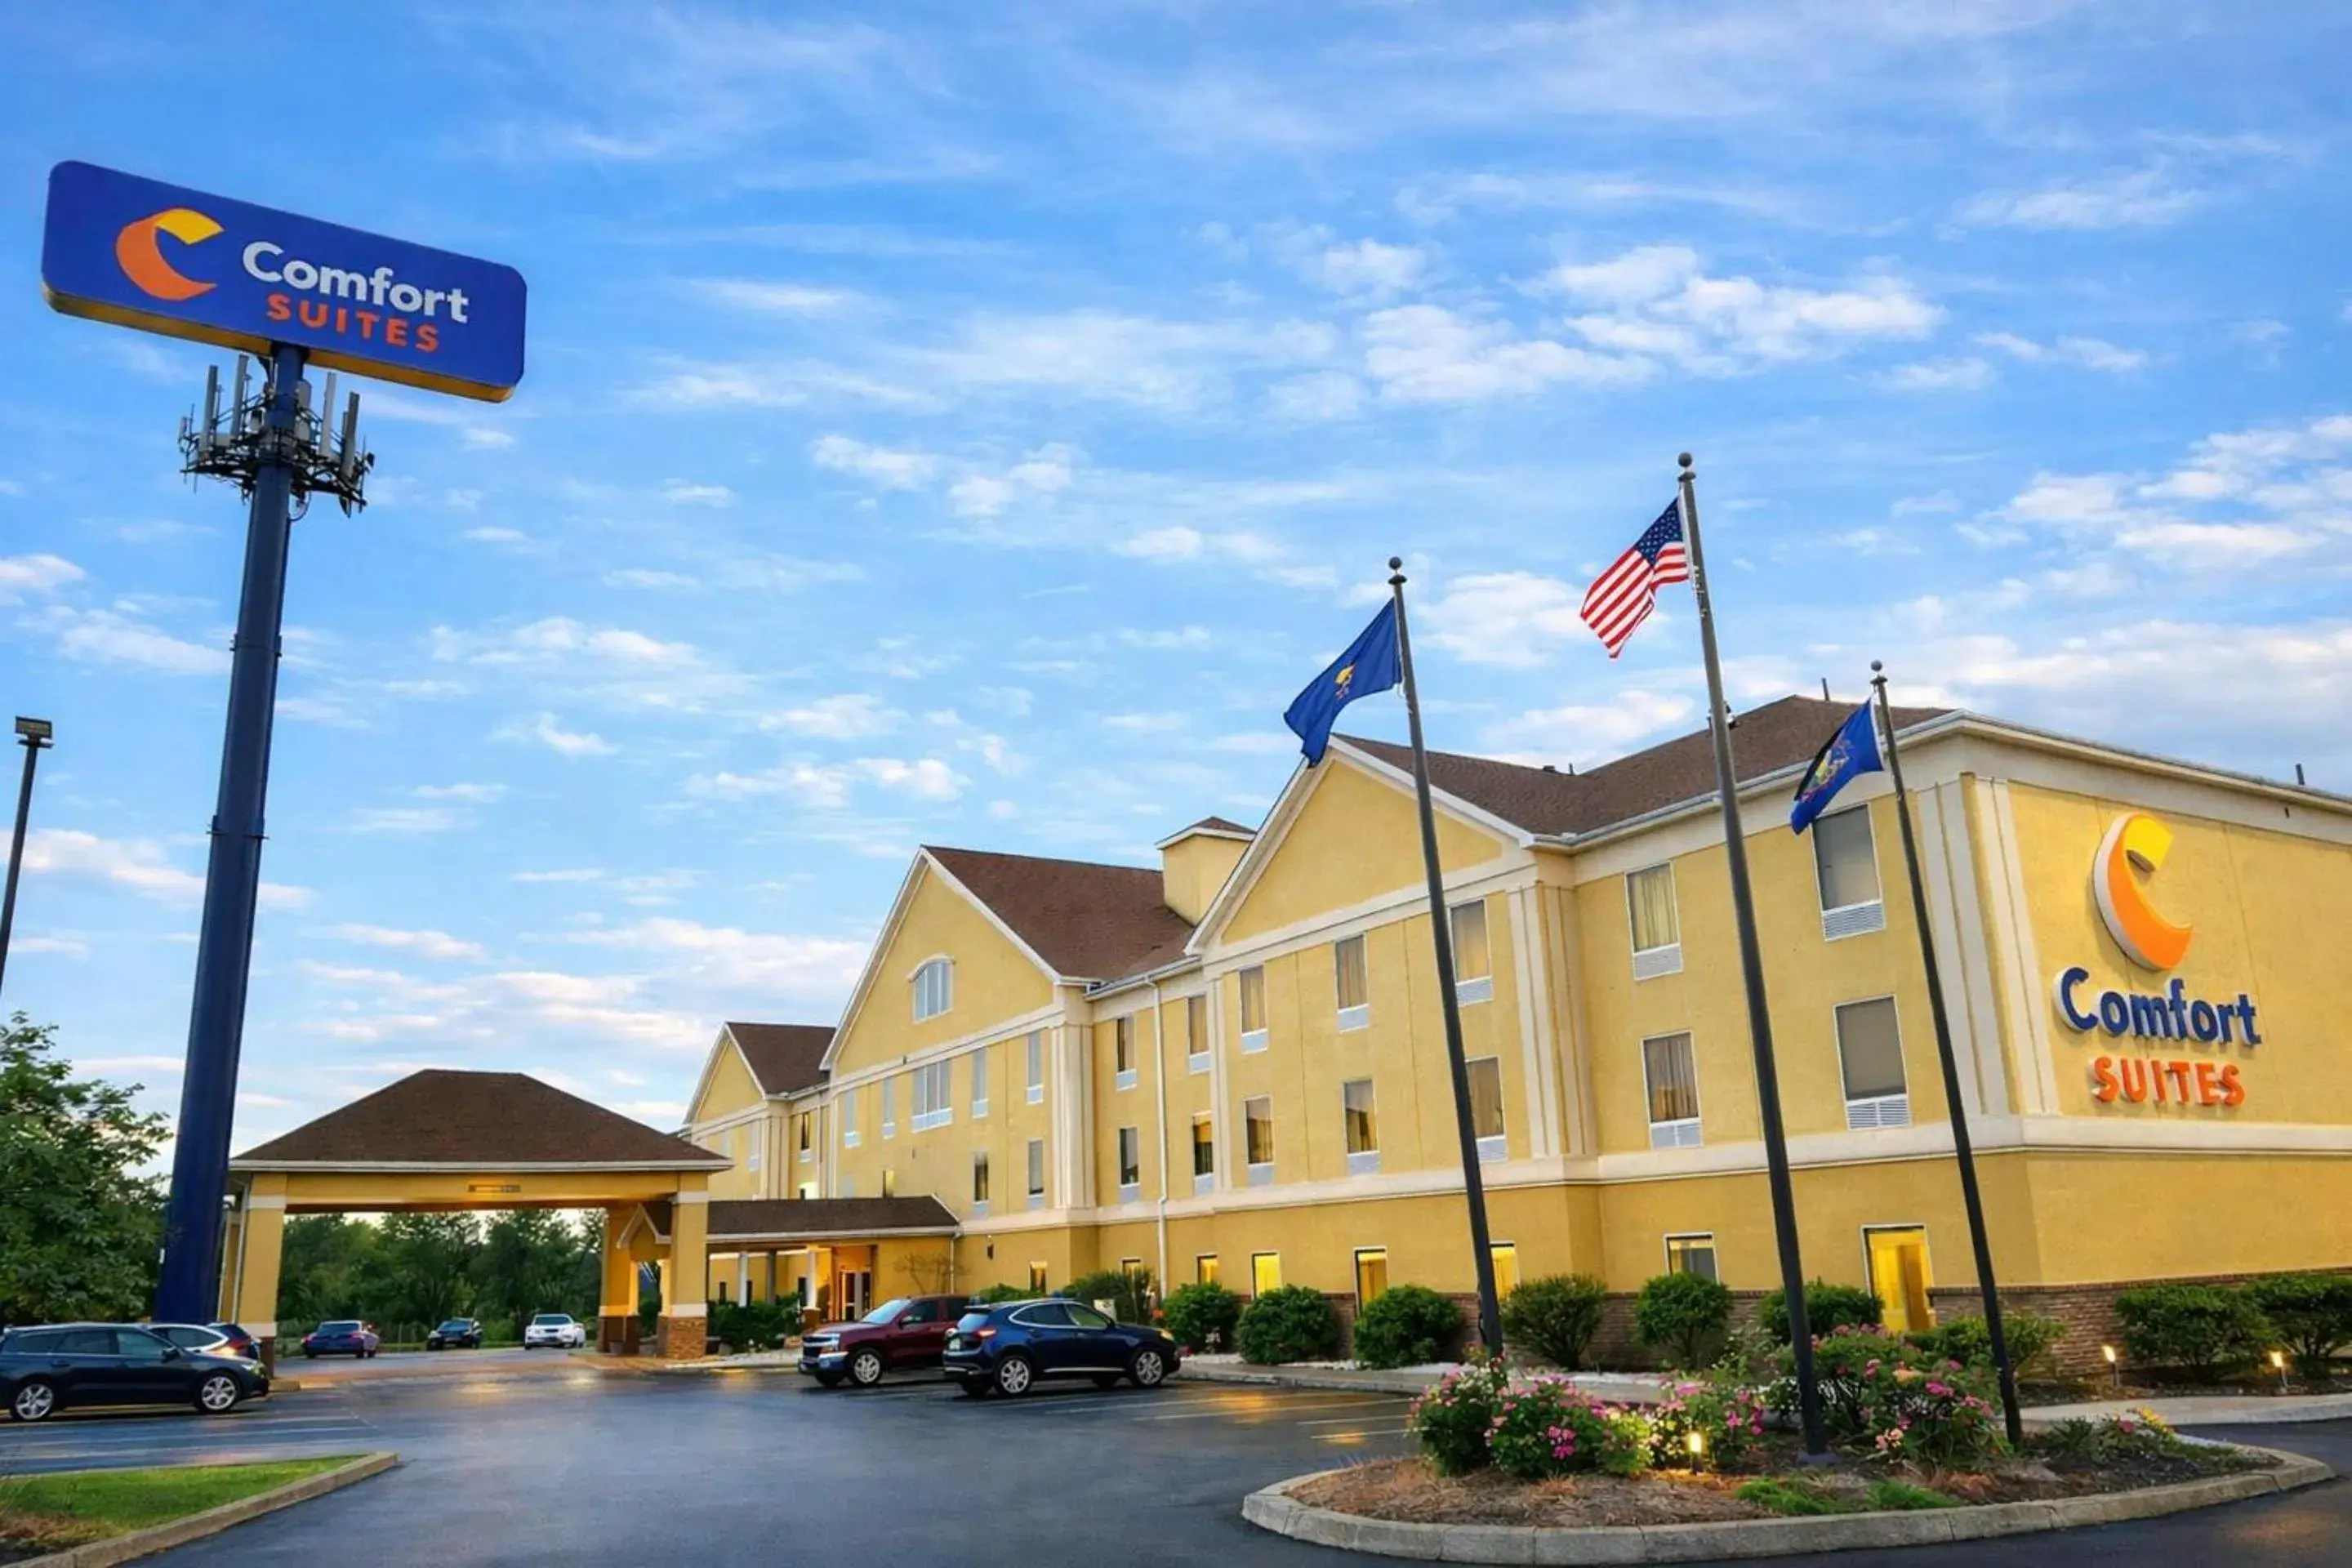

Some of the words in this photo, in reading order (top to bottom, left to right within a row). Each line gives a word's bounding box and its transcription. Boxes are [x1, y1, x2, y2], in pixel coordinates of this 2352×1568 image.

[243, 242, 469, 323] Comfort
[267, 294, 439, 351] SUITES
[2055, 966, 2261, 1045] Comfort
[2090, 1056, 2245, 1106] SUITES
